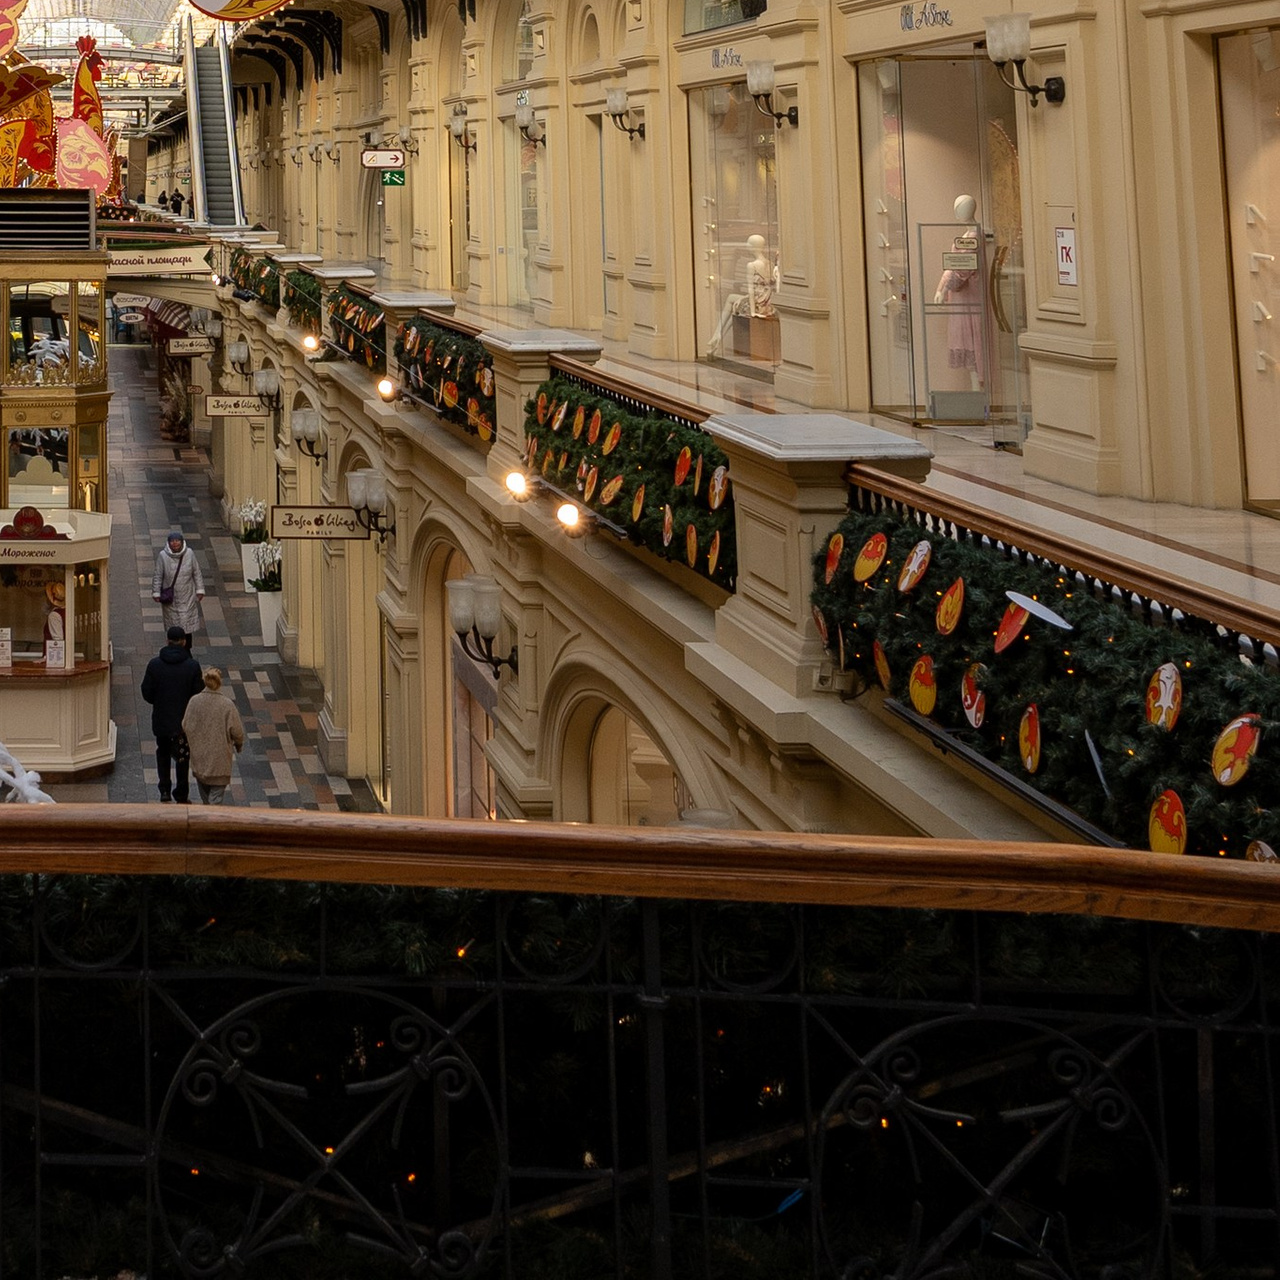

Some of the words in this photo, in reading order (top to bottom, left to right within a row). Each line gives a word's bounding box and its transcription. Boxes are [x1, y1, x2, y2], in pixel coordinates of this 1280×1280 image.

[146, 256, 192, 268] площади
[282, 513, 312, 529] Bosco
[0, 547, 56, 558] Мороженое
